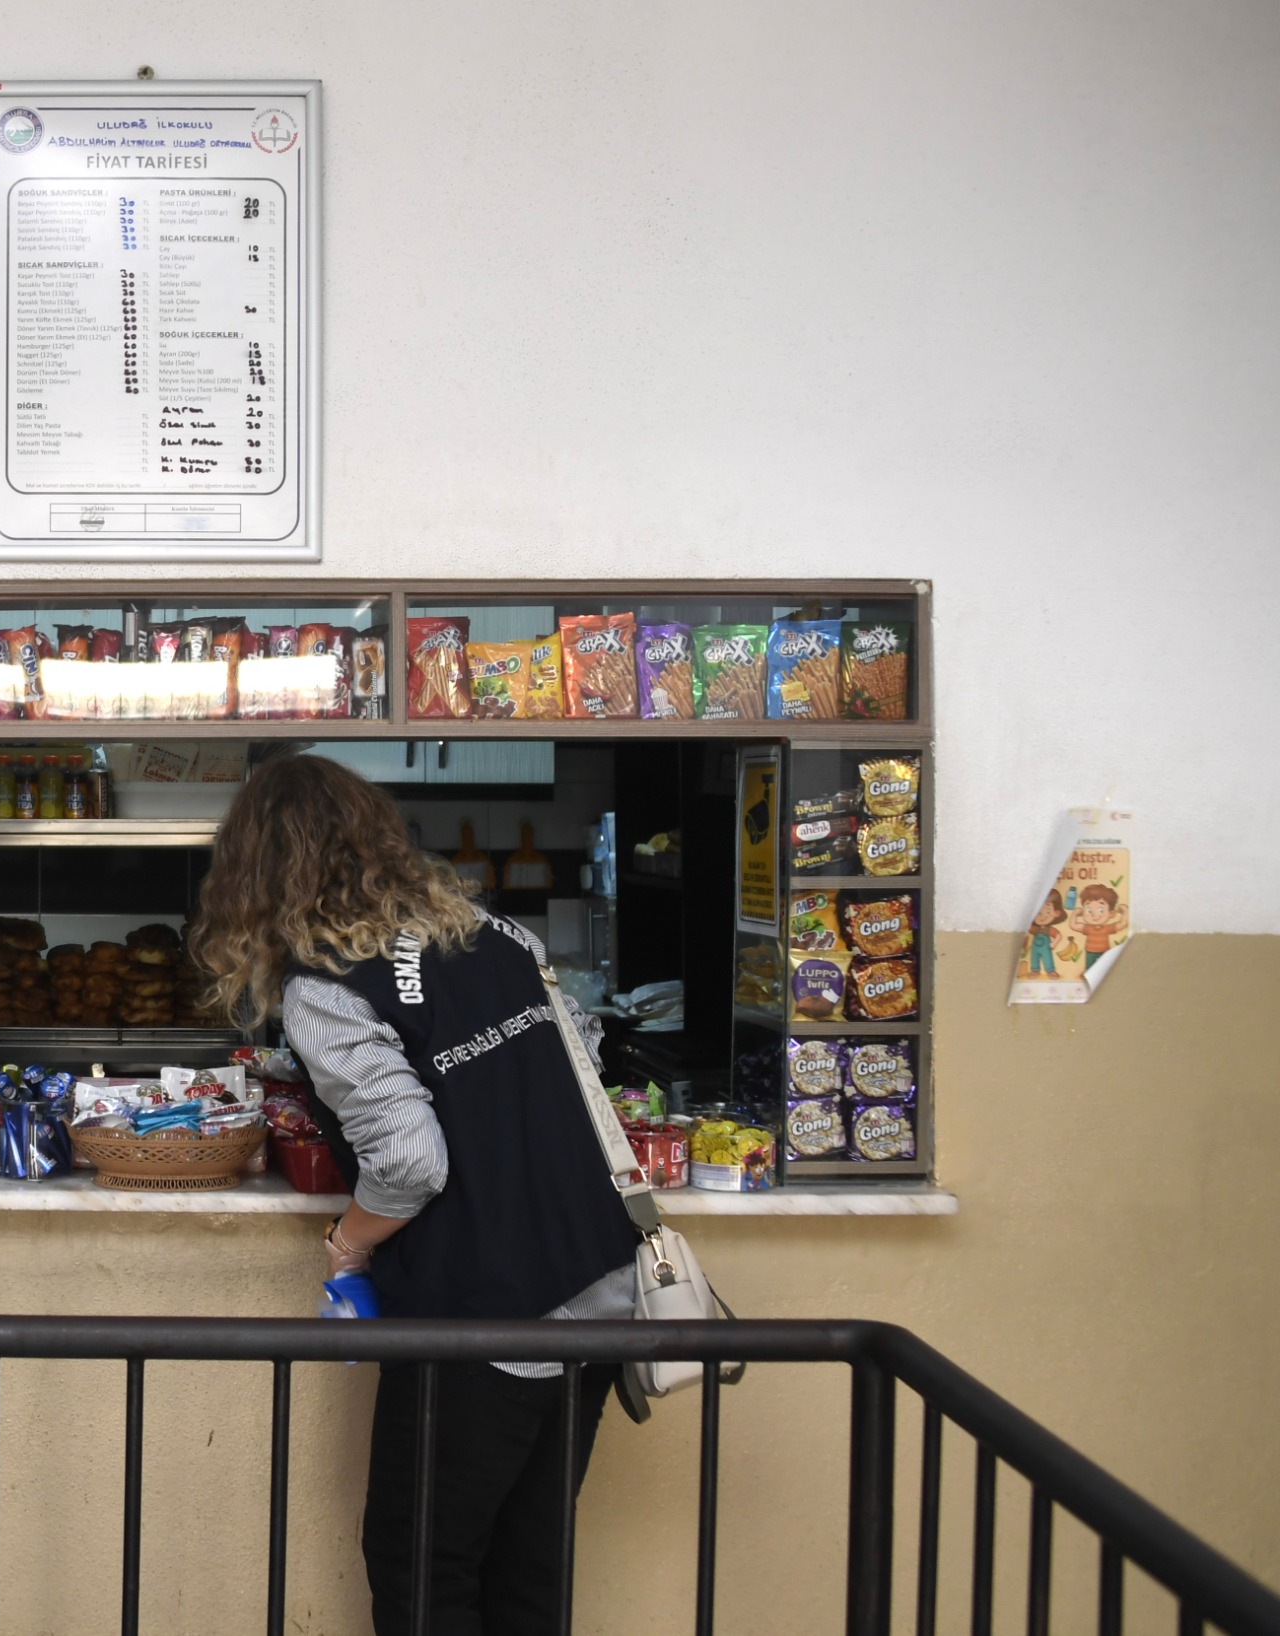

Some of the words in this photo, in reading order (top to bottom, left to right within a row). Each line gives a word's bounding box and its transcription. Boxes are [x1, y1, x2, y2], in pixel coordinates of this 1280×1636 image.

[87, 152, 132, 170] FİYAT
[138, 152, 208, 170] TARİFESİ
[189, 189, 231, 197] ÜRÜNLERİ
[18, 261, 45, 269] SICAK
[192, 331, 239, 340] İÇECEKLER
[246, 407, 263, 417] 20
[577, 627, 626, 654] CRAX
[646, 632, 692, 662] CRAX
[780, 629, 829, 660] CRAX
[704, 635, 755, 666] CRAX
[869, 780, 911, 796] Gong
[800, 823, 831, 836] ahenk
[866, 838, 907, 859] Gong
[1078, 867, 1098, 881] Ol!
[795, 894, 829, 915] MBO
[859, 917, 901, 936] Gong
[798, 968, 840, 979] LUPPO
[863, 976, 905, 998] Gong
[795, 1057, 837, 1073] Gong
[856, 1059, 898, 1076] Gong
[184, 1083, 226, 1101] TODAY
[791, 1116, 833, 1136] Gong
[859, 1122, 900, 1141] Gong
